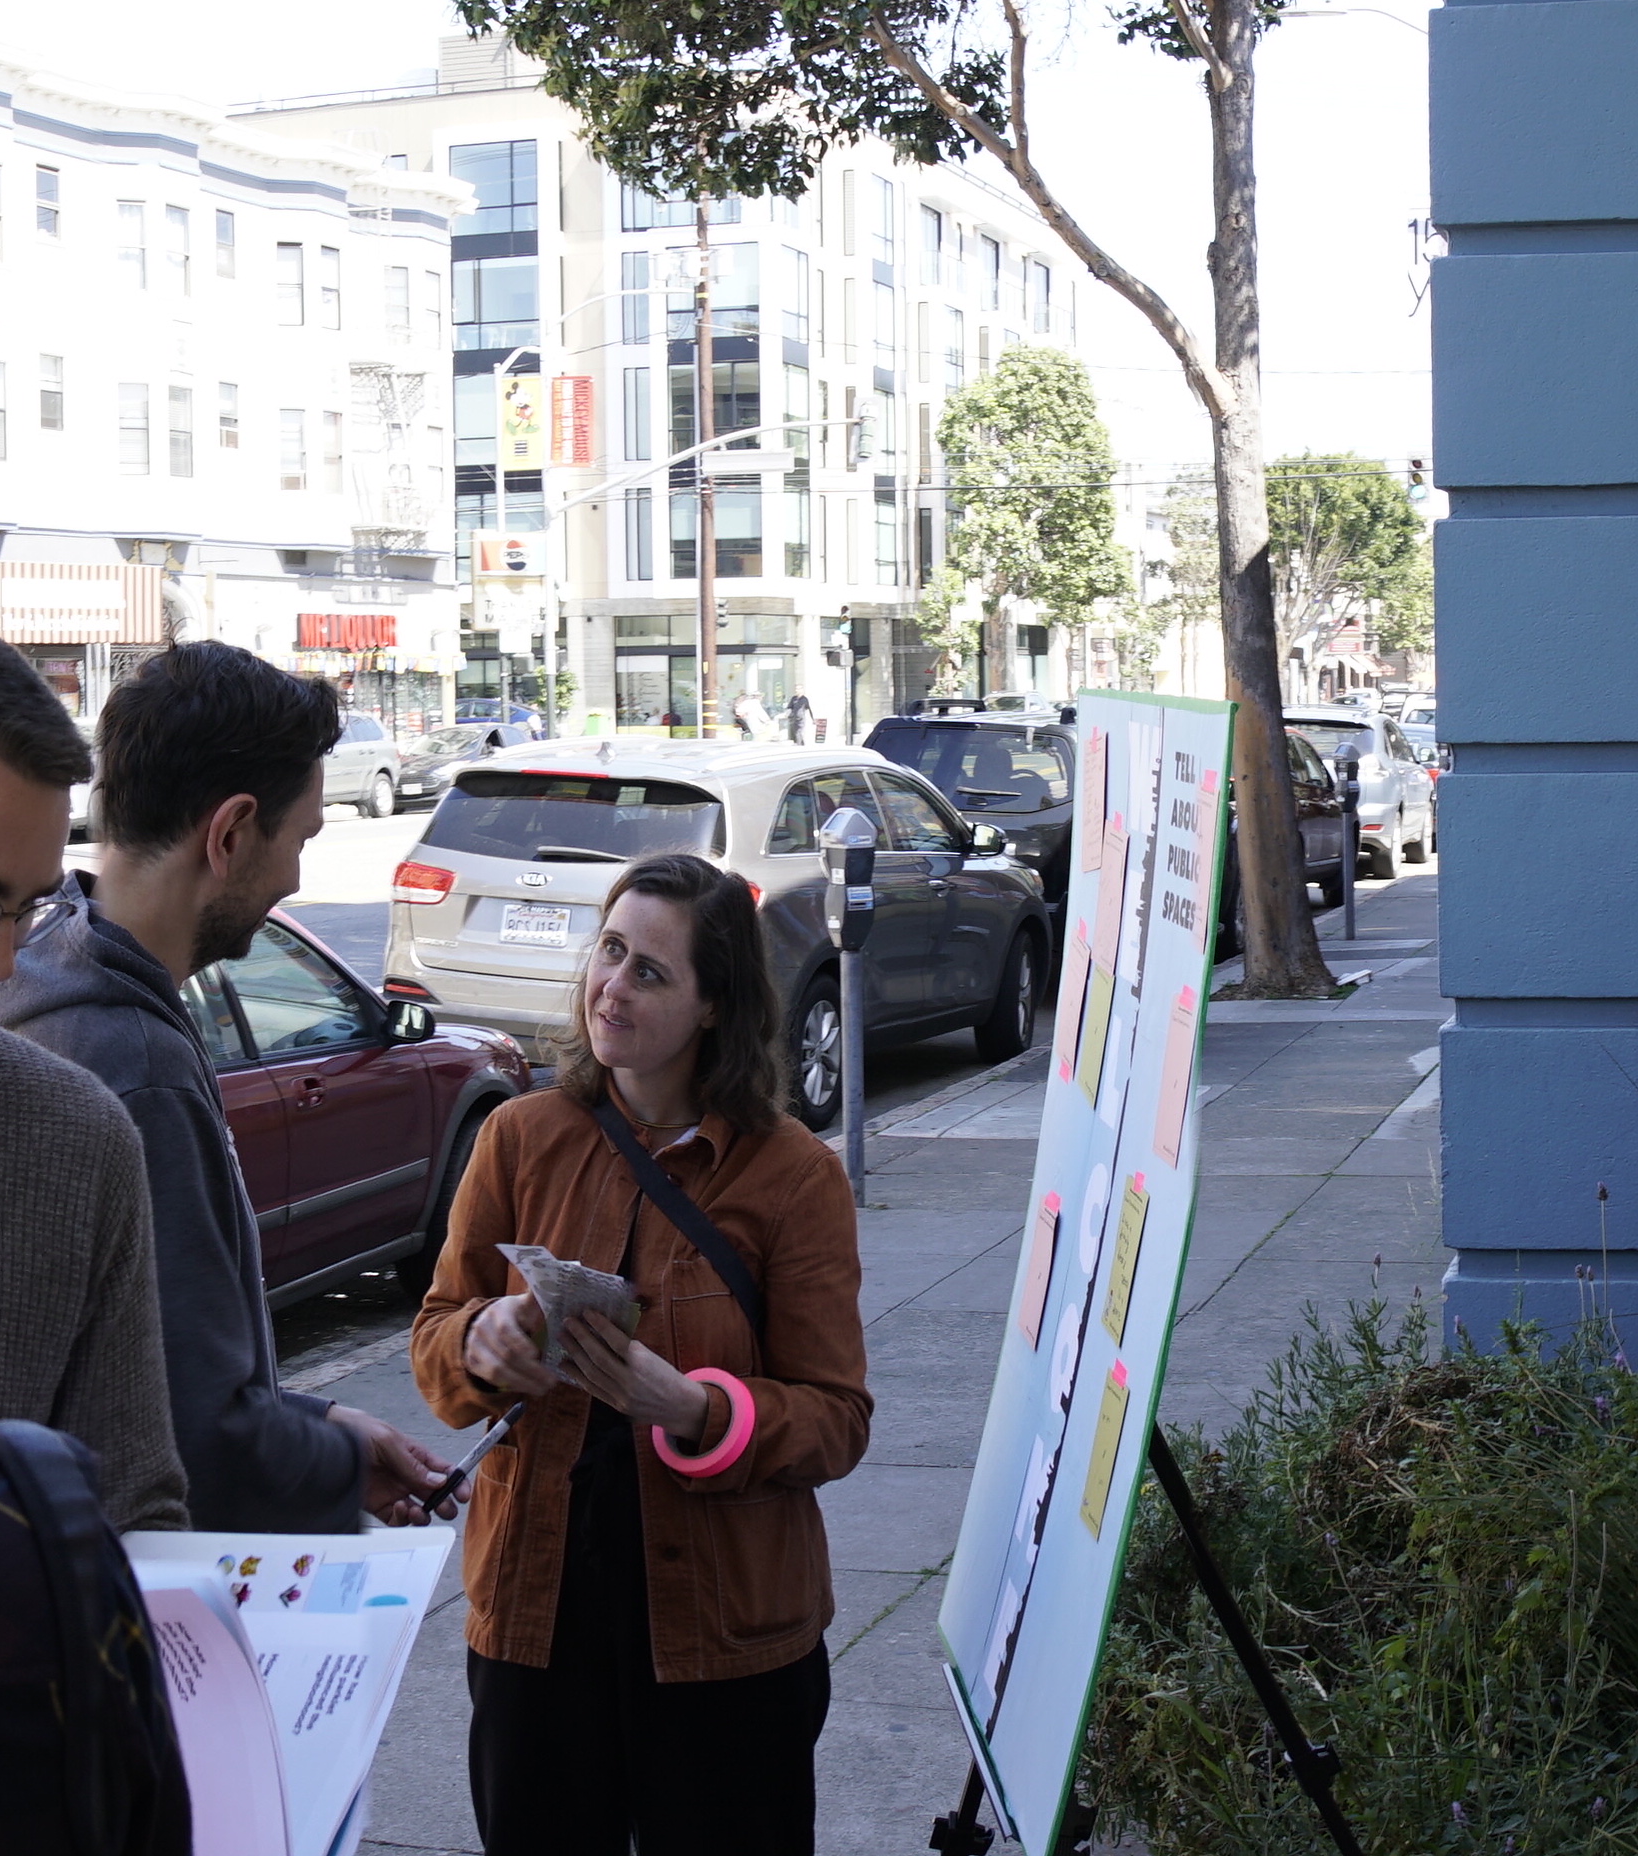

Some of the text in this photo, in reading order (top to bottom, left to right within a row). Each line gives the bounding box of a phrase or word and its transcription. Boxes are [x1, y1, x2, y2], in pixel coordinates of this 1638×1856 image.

[573, 424, 589, 463] MOUSE
[329, 613, 398, 653] LIQUOR
[1174, 750, 1196, 784] TELL
[1167, 842, 1200, 884] PUBLIC
[1161, 890, 1197, 933] SPACES
